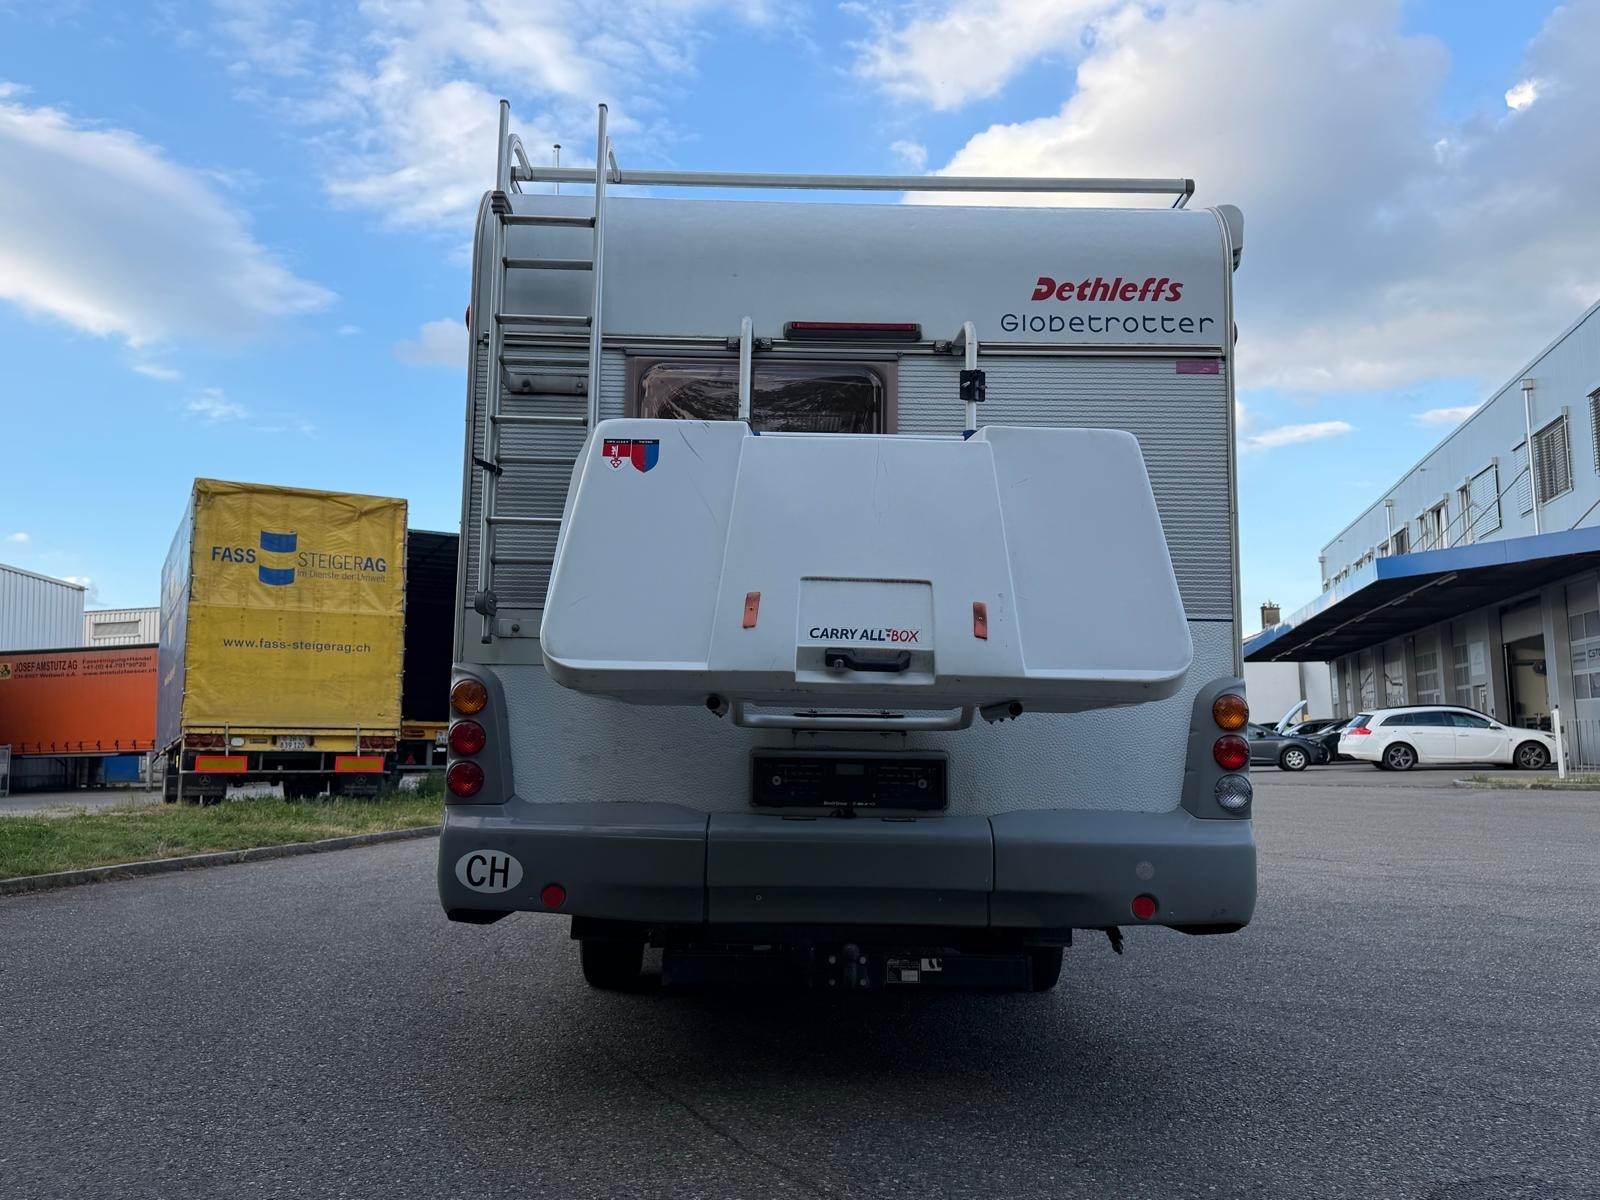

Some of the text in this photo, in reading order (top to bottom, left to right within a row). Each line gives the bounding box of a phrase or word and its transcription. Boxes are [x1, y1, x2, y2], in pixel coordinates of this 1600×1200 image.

[1031, 277, 1184, 302] Dethleffs
[1000, 313, 1215, 334] Globetrotter
[211, 546, 256, 564] FASS
[309, 569, 340, 580] Dienste
[342, 572, 355, 581] der
[809, 627, 858, 640] CARRY
[223, 637, 371, 654] www.fass-steigerag.ch
[14, 659, 78, 673] JOSEF AMSTUTZ AG
[466, 855, 510, 888] CH
